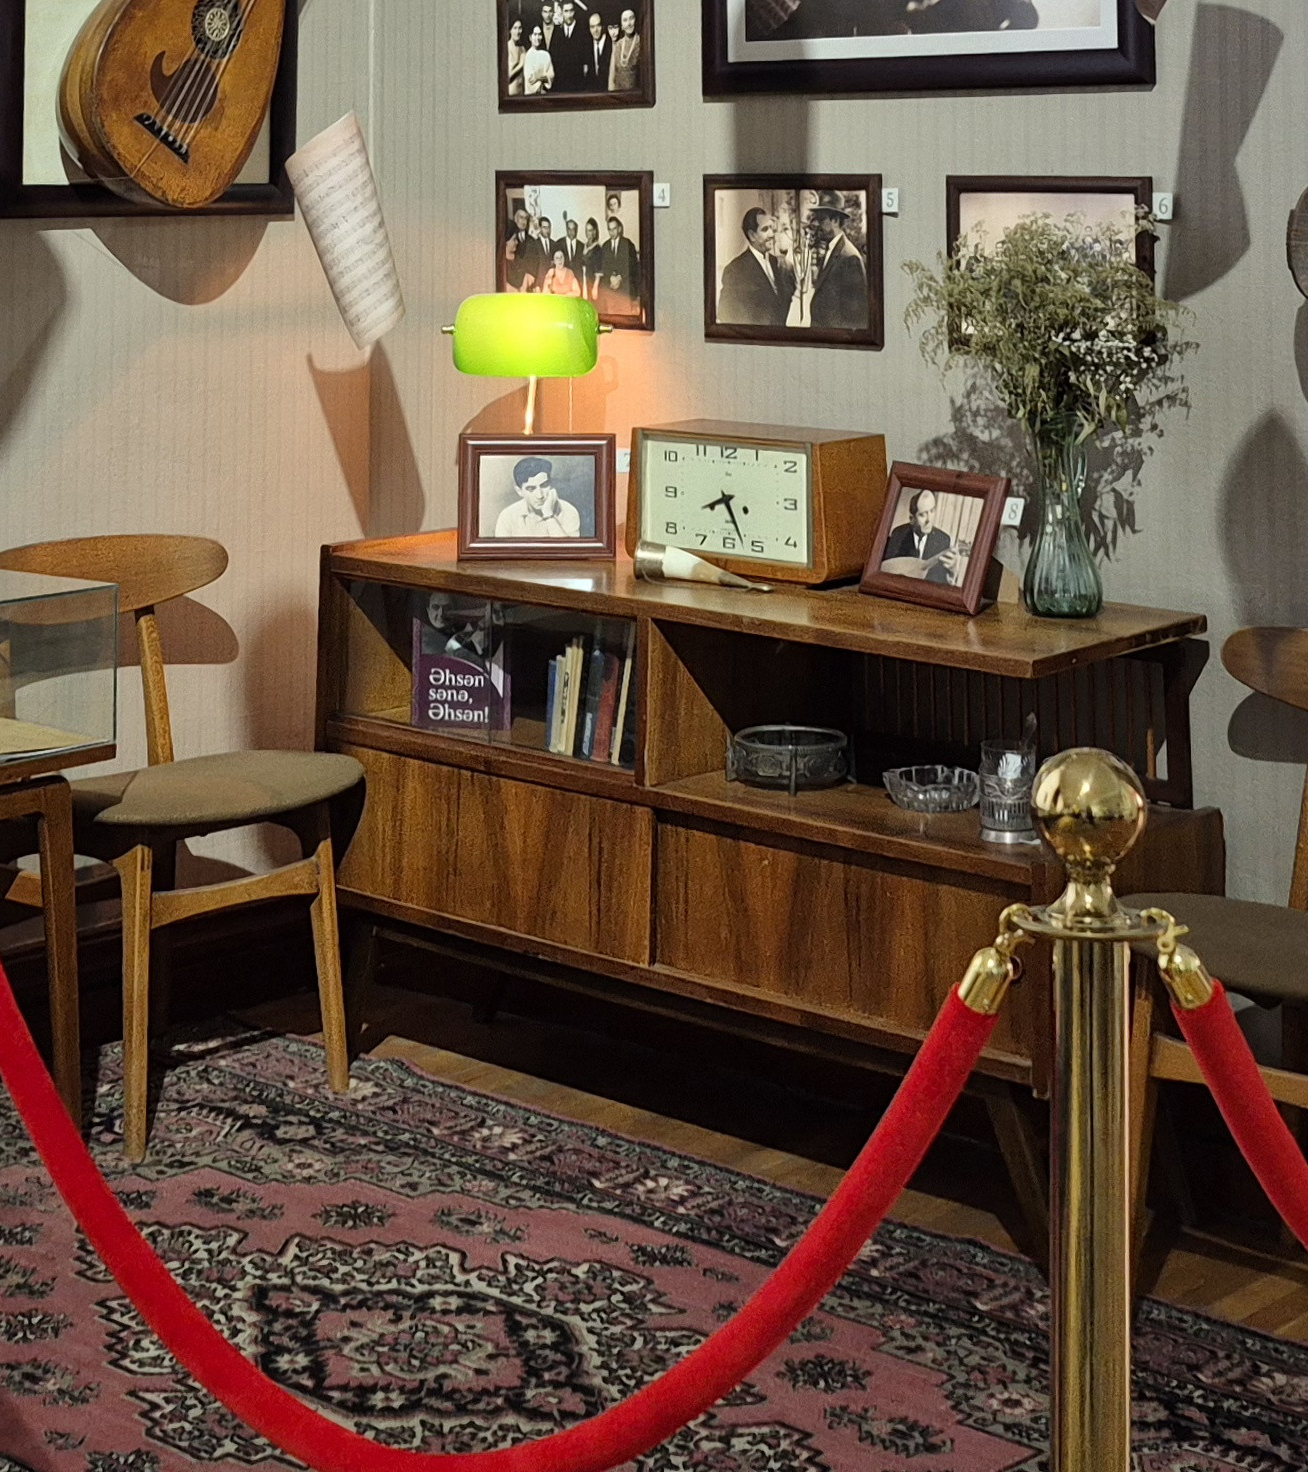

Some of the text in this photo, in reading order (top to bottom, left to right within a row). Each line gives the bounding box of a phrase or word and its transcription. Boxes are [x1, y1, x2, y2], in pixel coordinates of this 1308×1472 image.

[657, 188, 665, 202] 4
[886, 192, 894, 207] 5
[1158, 197, 1168, 214] 6
[664, 450, 678, 462] 10
[696, 444, 707, 457] 11
[720, 446, 738, 460] 12
[754, 449, 759, 461] 1
[783, 460, 798, 473] 2
[665, 486, 678, 498] 9
[783, 498, 798, 511] 3
[1008, 503, 1019, 520] 8
[665, 522, 678, 535] 8
[695, 533, 708, 546] 7
[722, 537, 736, 549] 6
[784, 536, 798, 548] 4
[751, 540, 764, 553] 5
[429, 668, 484, 687] Əhsən
[428, 688, 473, 704] sənə,
[428, 703, 489, 724] Əhsən!
